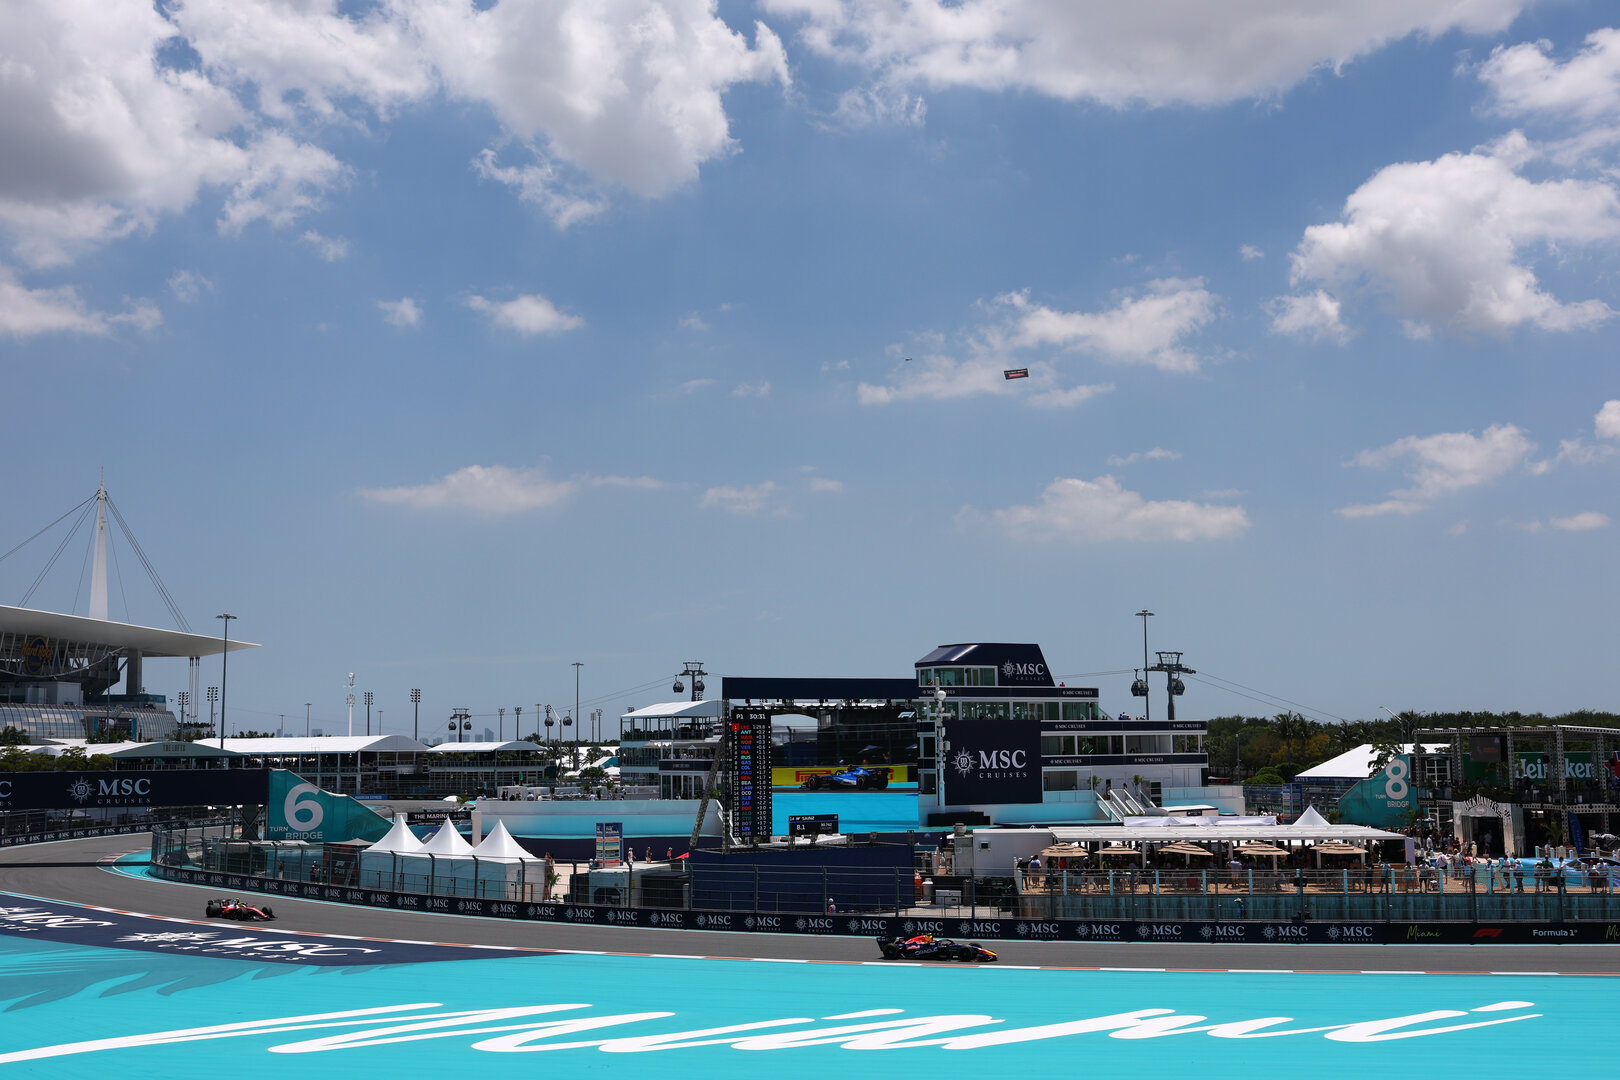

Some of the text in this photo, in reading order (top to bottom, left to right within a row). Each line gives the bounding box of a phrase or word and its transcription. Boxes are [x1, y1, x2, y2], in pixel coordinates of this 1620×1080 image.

[1016, 663, 1044, 675] MSC
[978, 750, 1026, 769] MSC
[1385, 759, 1408, 800] 8
[98, 779, 151, 796] MSC
[284, 783, 324, 831] 6
[285, 832, 323, 840] BRIDGE
[329, 888, 341, 898] MSC
[352, 891, 363, 900] MSC
[376, 894, 390, 903] MSC
[403, 897, 418, 905] MSC
[433, 898, 449, 908] MSC
[466, 901, 482, 910] MSC
[500, 904, 517, 913] MSC
[537, 906, 555, 915] MSC
[575, 909, 595, 918] MSC
[617, 911, 638, 920] MSC
[661, 913, 683, 922] MSC
[708, 915, 731, 925] MSC
[757, 917, 781, 926] MSC
[808, 918, 833, 928] MSC
[861, 920, 887, 930] MSC
[917, 921, 944, 931] MSC
[974, 922, 1001, 932] MSC
[1031, 923, 1059, 933] MSC
[1091, 925, 1120, 934] MSC
[1152, 925, 1182, 935] MSC
[1215, 925, 1245, 936] MSC
[1278, 926, 1308, 936] MSC
[1342, 926, 1373, 937] MSC
[1406, 924, 1441, 940] Miami
[1533, 929, 1568, 937] Formula
[190, 937, 382, 956] MSC
[0, 1001, 1544, 1063] Miami
